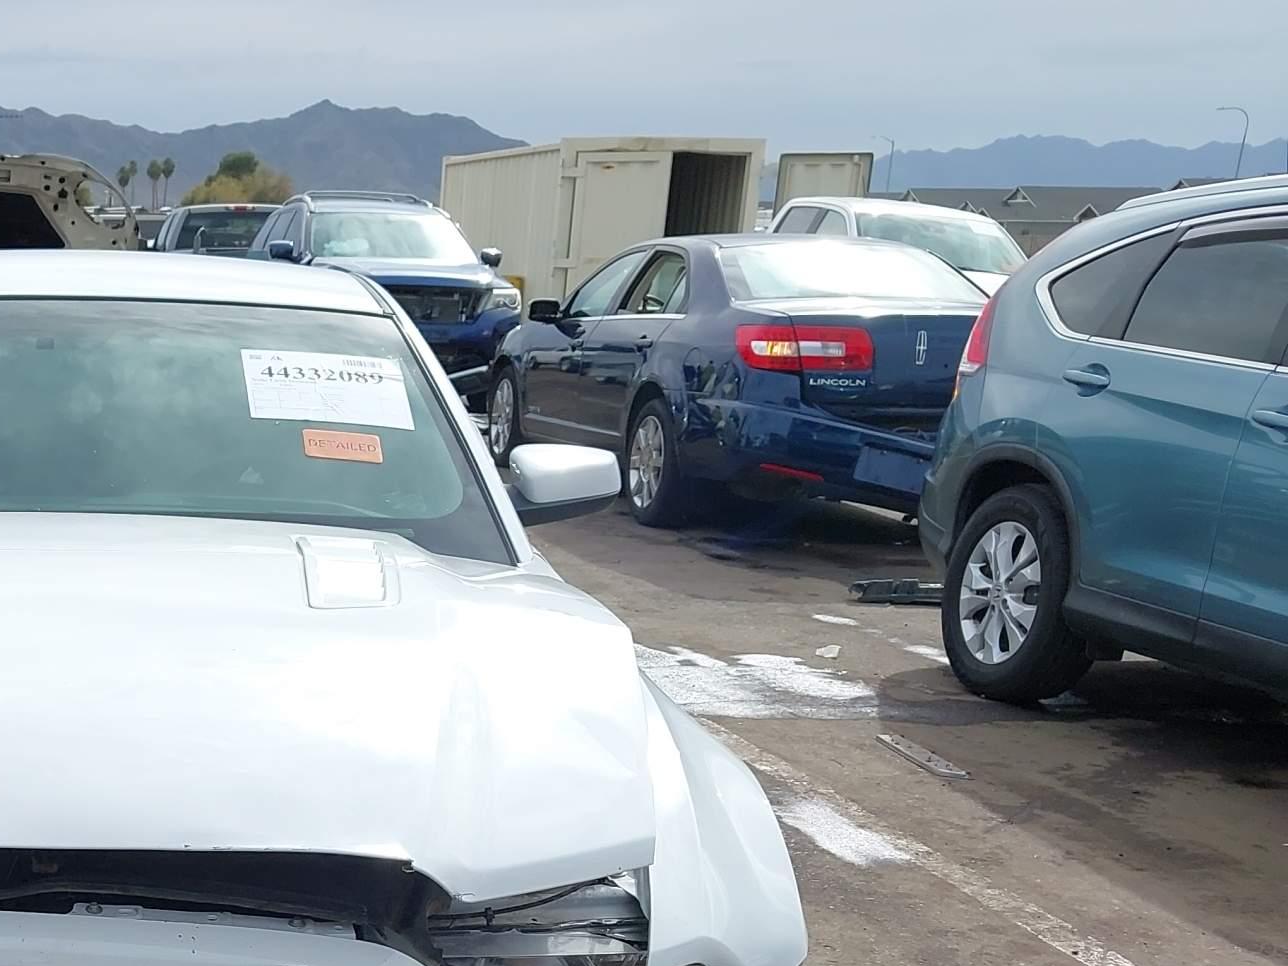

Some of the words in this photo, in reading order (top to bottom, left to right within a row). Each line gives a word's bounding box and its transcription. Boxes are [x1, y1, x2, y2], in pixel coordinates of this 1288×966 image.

[260, 365, 384, 385] 44332089
[809, 377, 866, 387] LINCOLN
[308, 438, 377, 453] DETAILED
